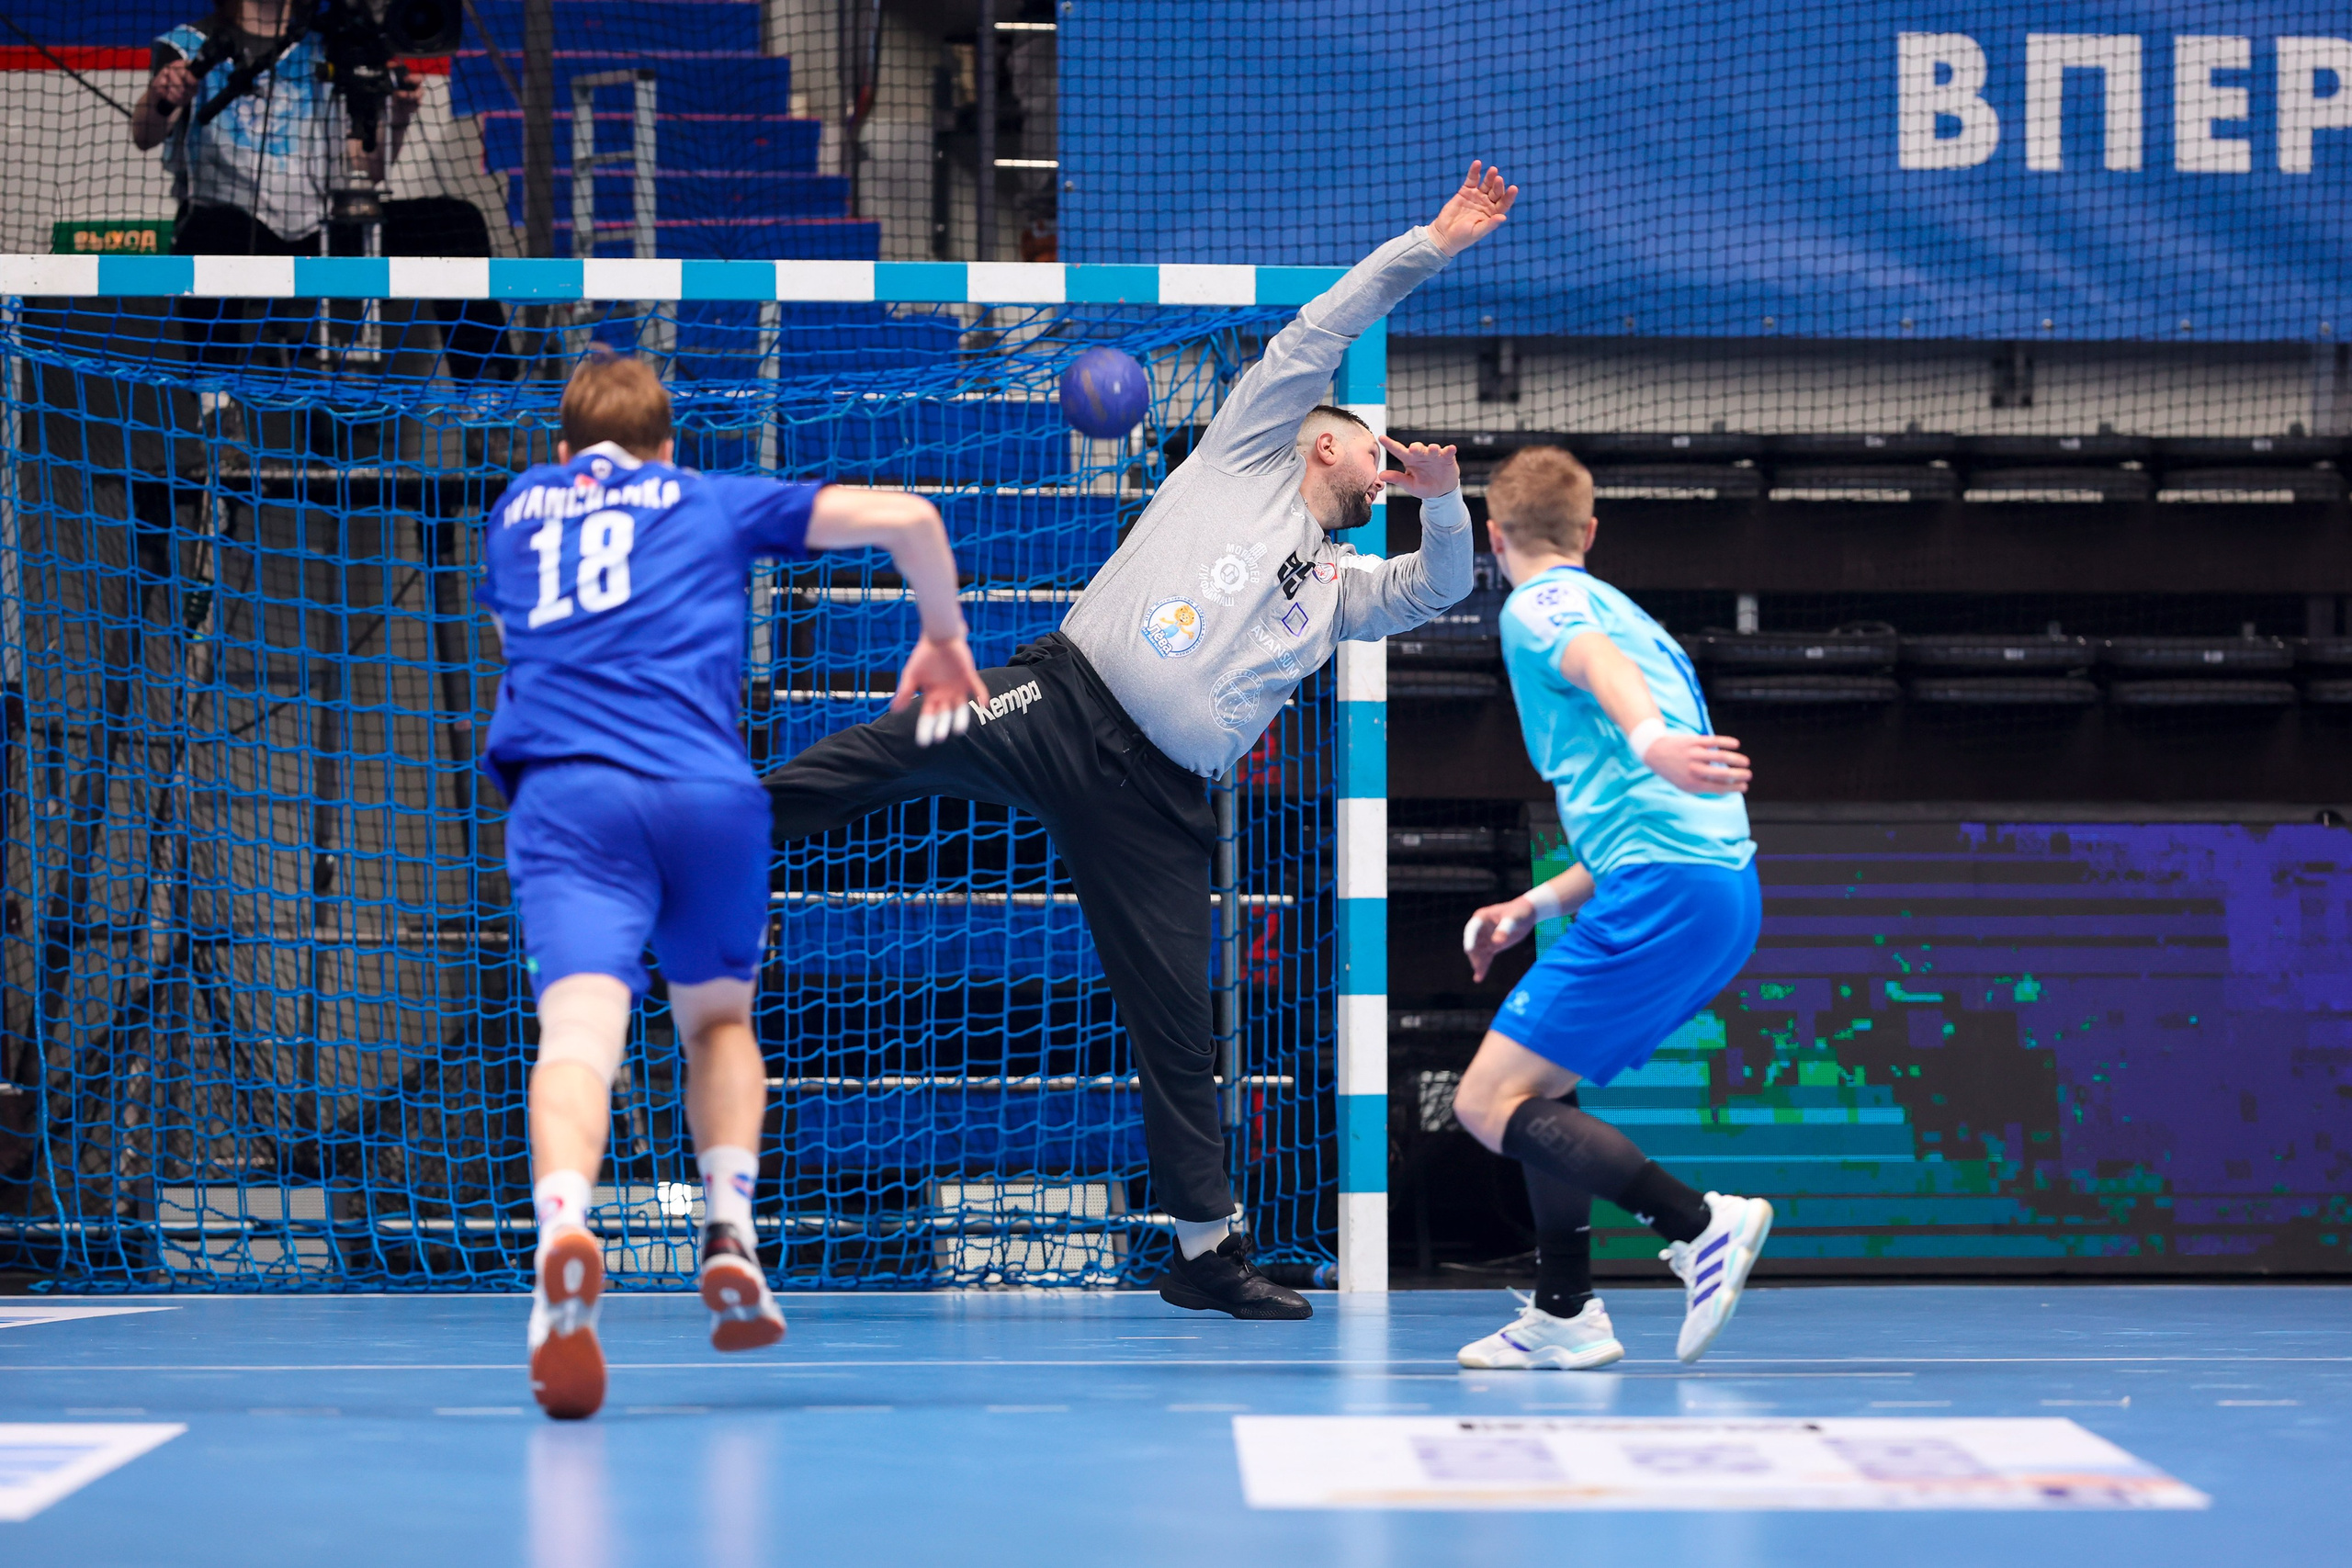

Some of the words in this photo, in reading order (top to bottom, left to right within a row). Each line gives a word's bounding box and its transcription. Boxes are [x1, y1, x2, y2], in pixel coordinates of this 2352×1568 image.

[1897, 31, 2352, 175] ВПЕР
[74, 230, 157, 254] ВЫХОД
[527, 510, 635, 629] 18
[1250, 625, 1300, 680] AVANSUM
[967, 680, 1043, 726] Kempa
